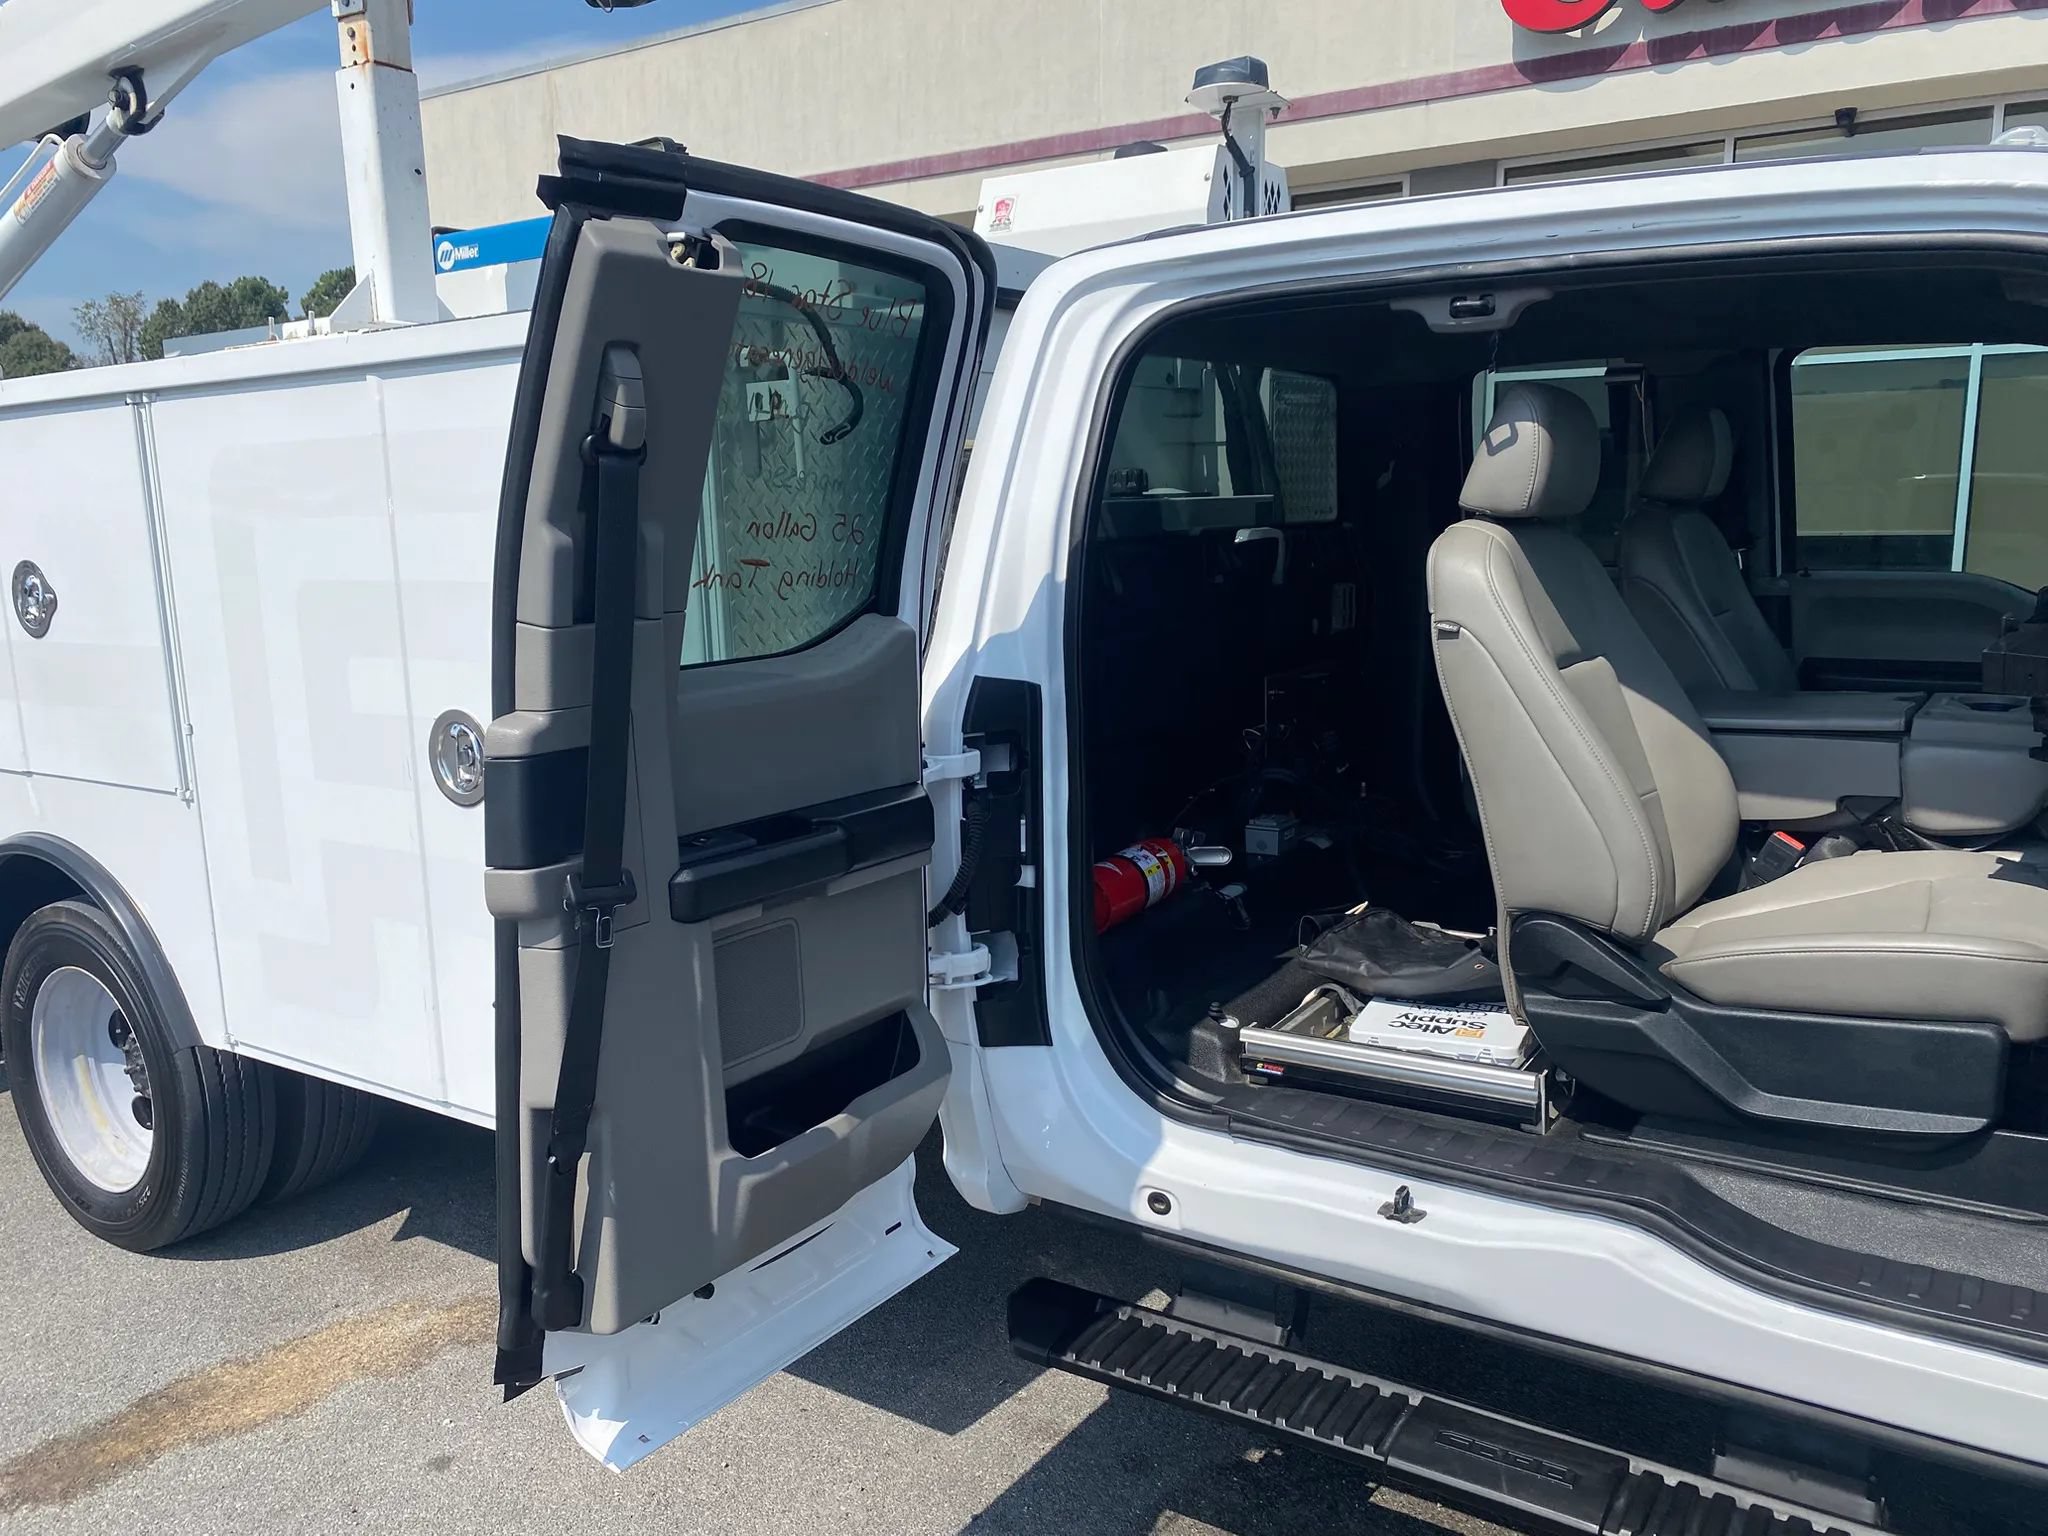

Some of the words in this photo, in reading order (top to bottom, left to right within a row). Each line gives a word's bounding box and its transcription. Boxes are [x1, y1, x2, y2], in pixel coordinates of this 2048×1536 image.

[454, 245, 479, 260] Miller
[1388, 1020, 1457, 1035] Altec
[1395, 1012, 1488, 1030] Supply
